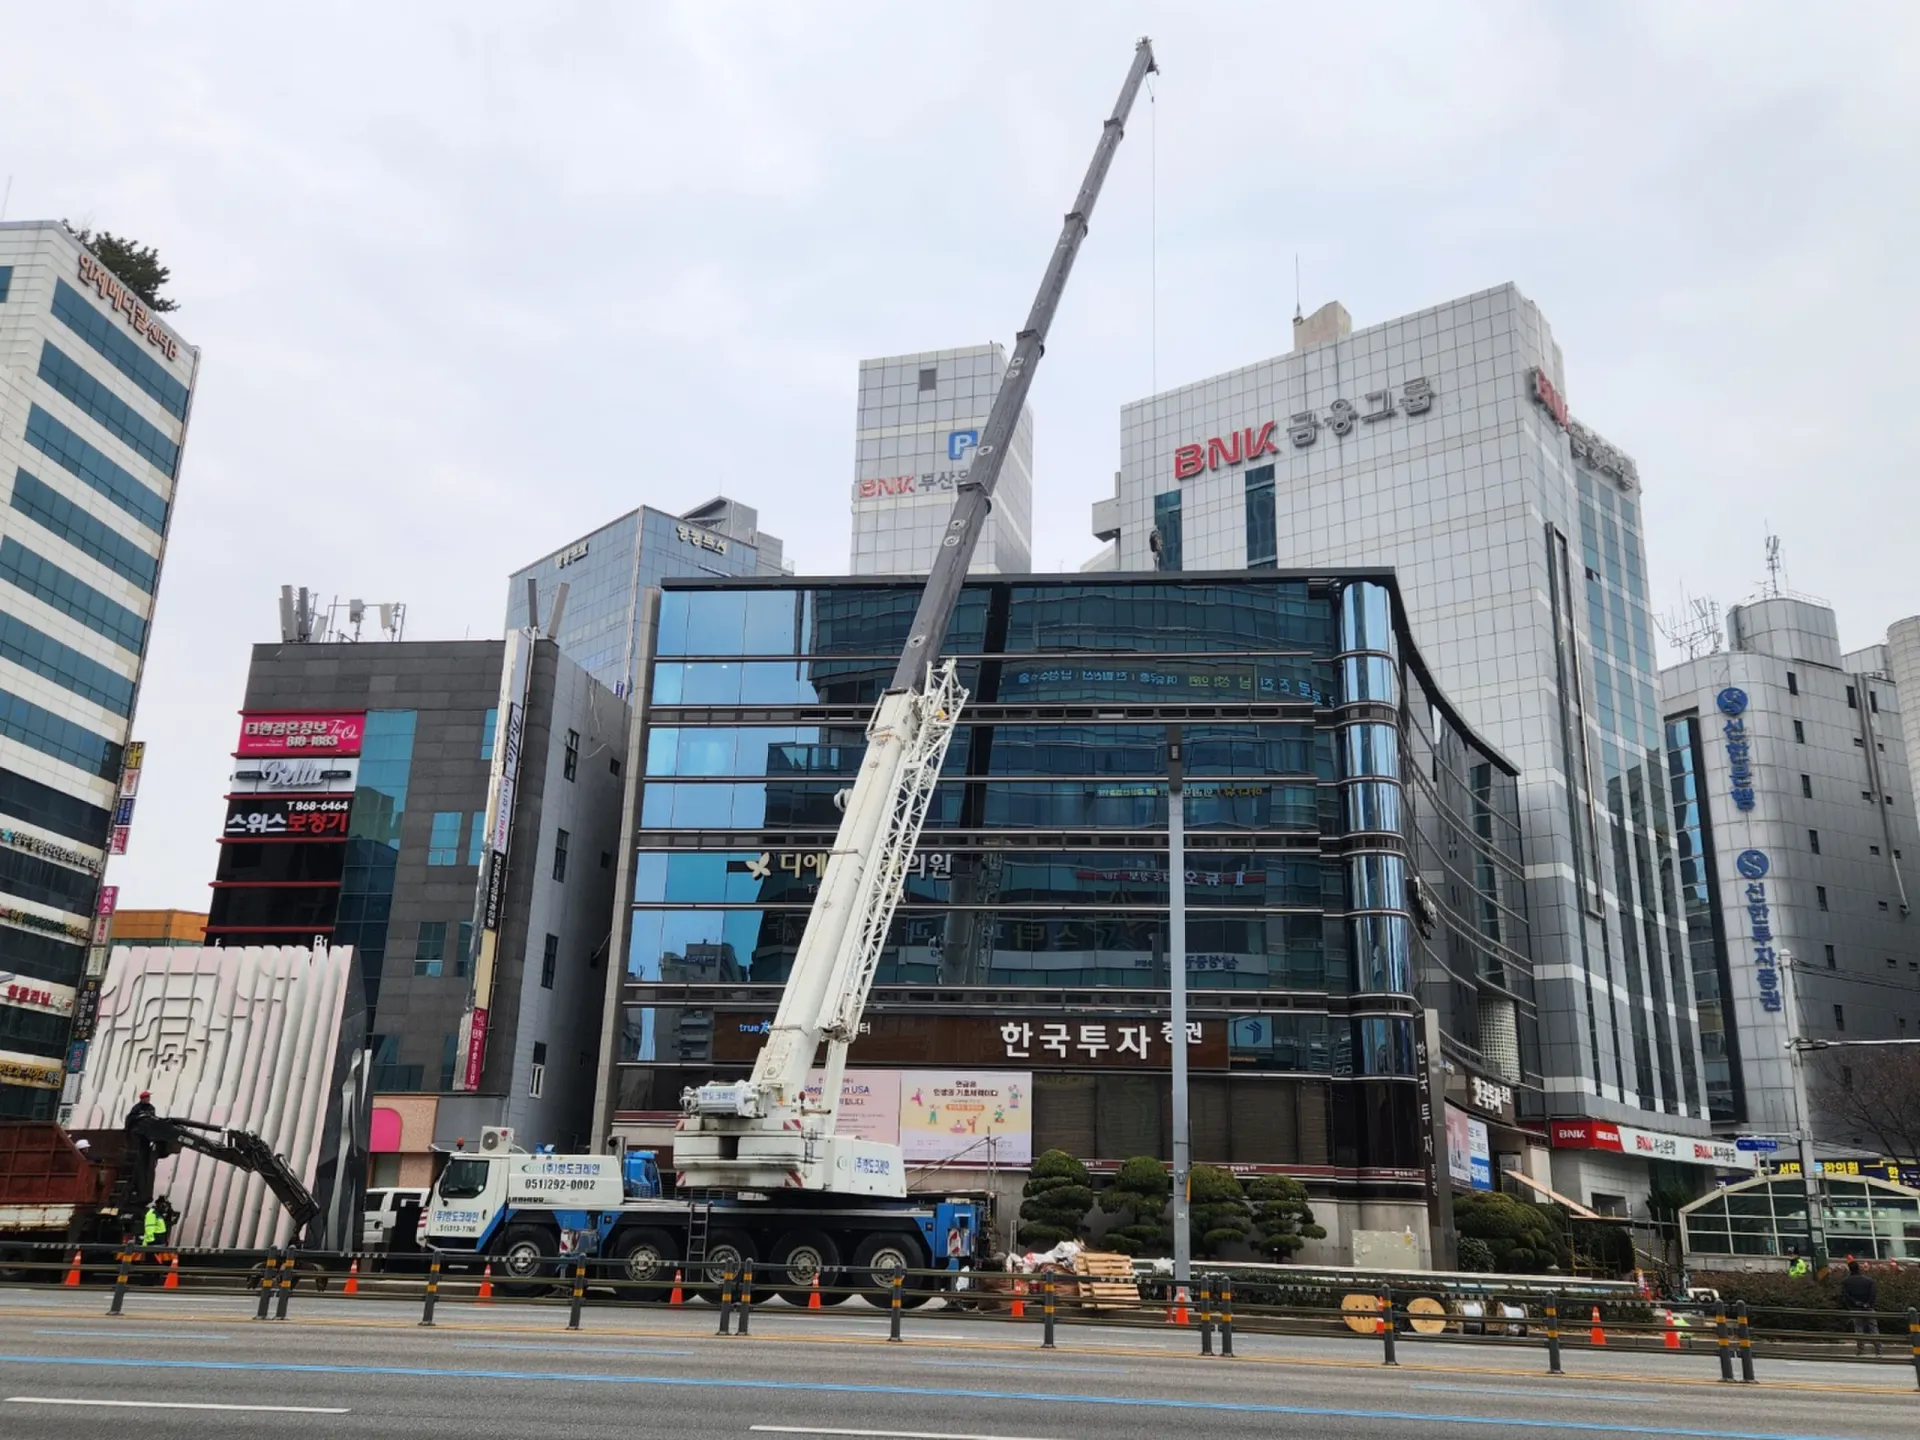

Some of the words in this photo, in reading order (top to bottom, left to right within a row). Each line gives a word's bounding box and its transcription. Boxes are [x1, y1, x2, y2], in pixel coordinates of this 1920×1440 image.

[1174, 420, 1279, 480] BNK
[1286, 376, 1436, 449] 금융그룹
[859, 475, 915, 498] BNK
[1722, 718, 1756, 813] 신한은행
[295, 801, 348, 811] 868-6464
[225, 812, 286, 833] 스위스
[286, 812, 348, 833] 보청기
[1744, 882, 1782, 1013] 신한투자증권
[852, 1085, 870, 1094] USA
[1559, 1129, 1586, 1139] BNK
[1778, 1162, 1801, 1175] 서면
[1823, 1161, 1860, 1175] 한의원
[525, 1178, 596, 1190] 051)292-0002
